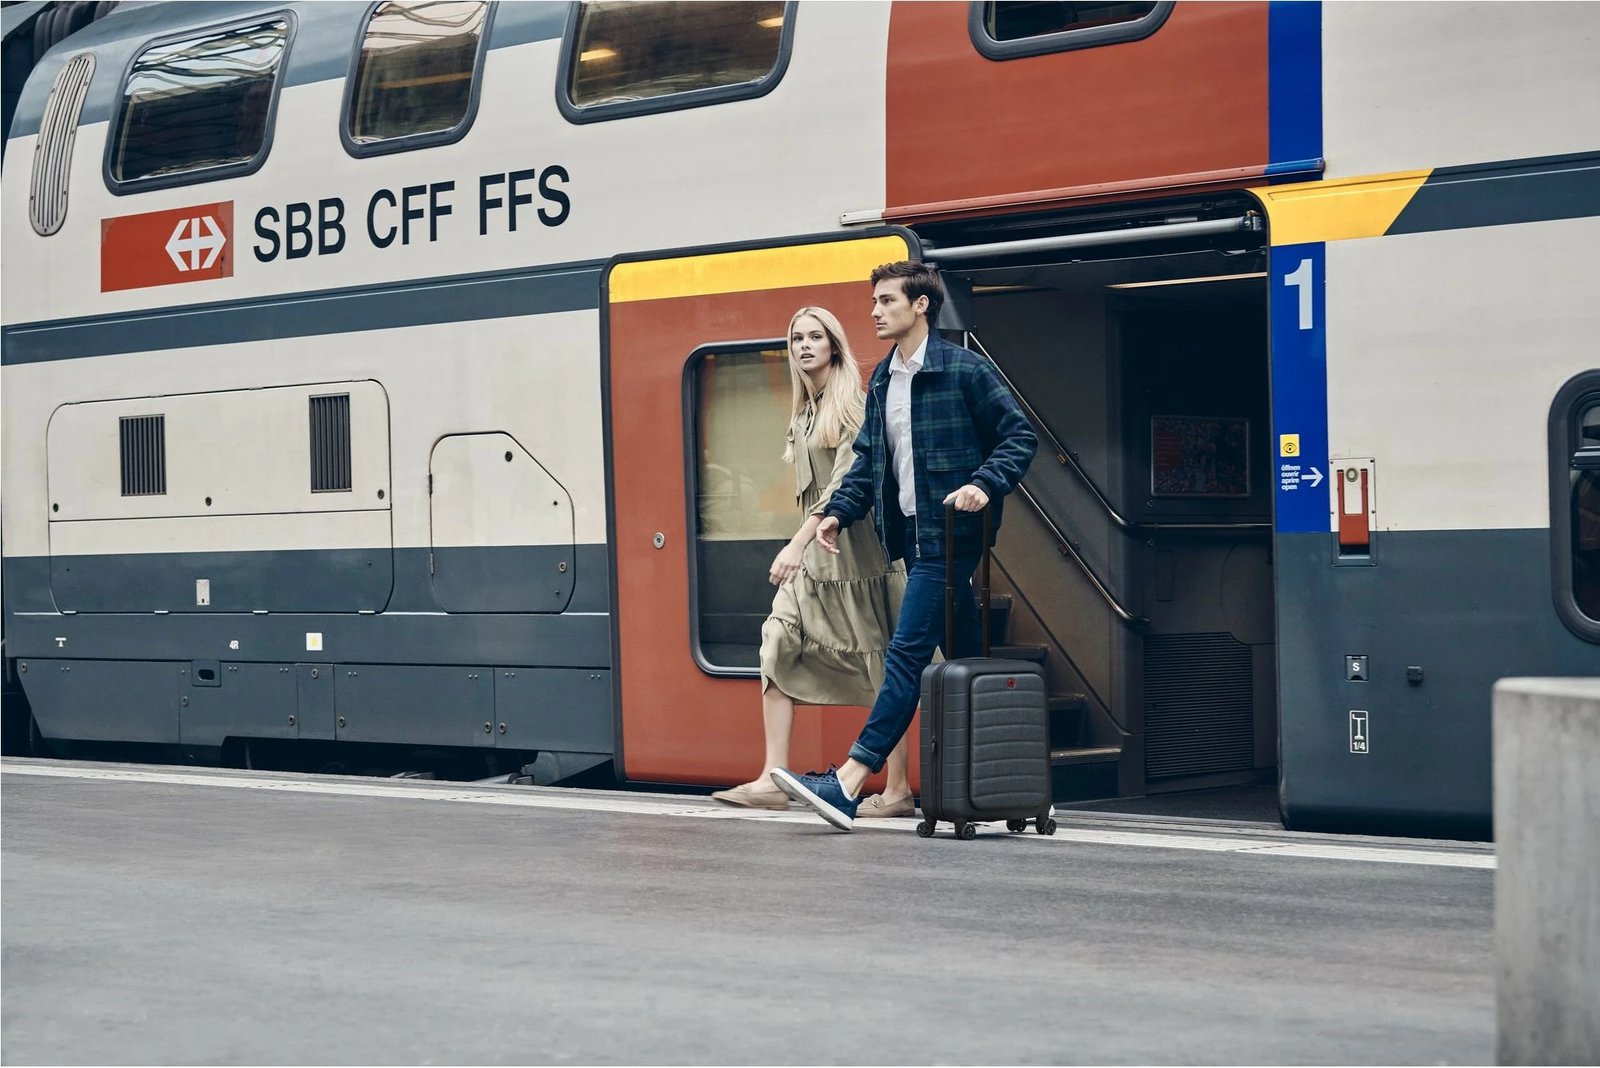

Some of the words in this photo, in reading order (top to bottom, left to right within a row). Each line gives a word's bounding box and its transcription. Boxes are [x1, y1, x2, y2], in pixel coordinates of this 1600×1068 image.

[253, 197, 346, 262] SBB
[367, 181, 455, 249] CFF
[479, 165, 571, 236] FFS
[1284, 258, 1313, 330] 1
[1352, 662, 1360, 671] S
[1352, 742, 1366, 750] 1/4
